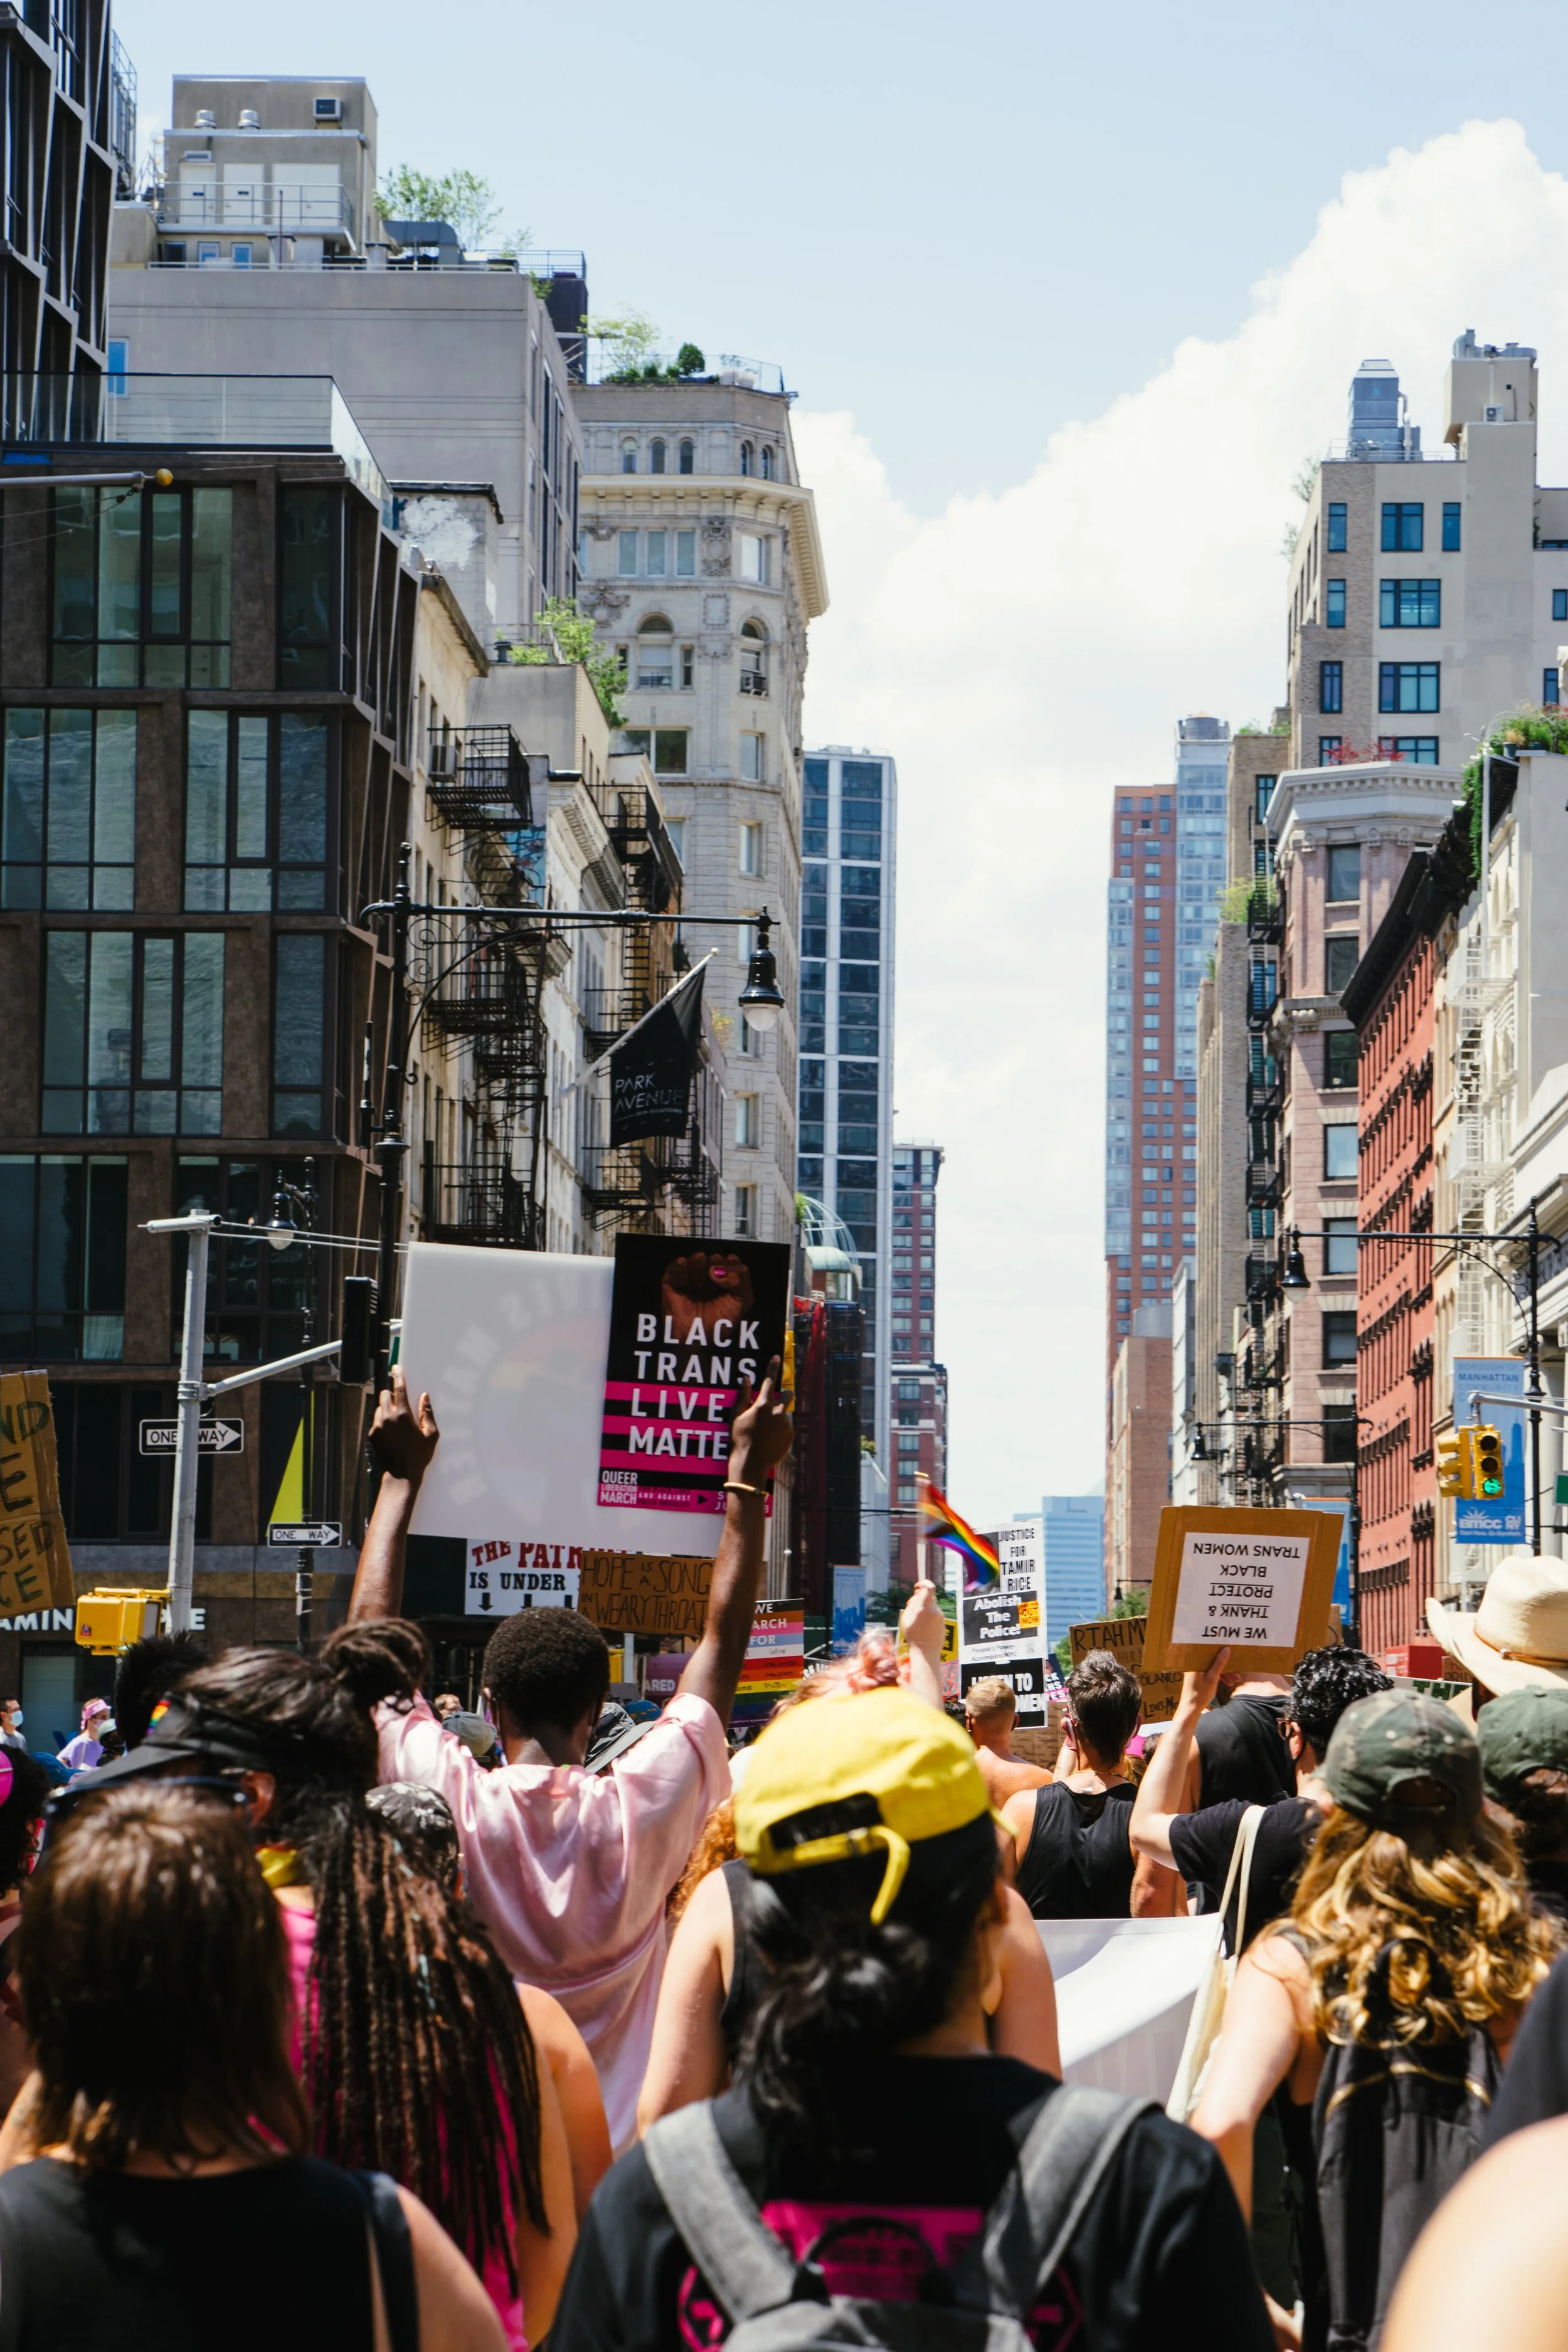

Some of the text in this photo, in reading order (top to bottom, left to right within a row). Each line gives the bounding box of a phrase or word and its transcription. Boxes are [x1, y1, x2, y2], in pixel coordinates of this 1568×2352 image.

[615, 1073, 656, 1094] PARK
[615, 1090, 684, 1115] AVENUE
[637, 1313, 760, 1350] BLACK
[633, 1350, 757, 1385] TRANS
[1458, 1373, 1519, 1382] MANHATTAN
[631, 1387, 725, 1422] LIVE
[150, 1430, 229, 1443] ONE WAY
[628, 1425, 729, 1460] MATTE
[602, 1470, 638, 1485] QUEER
[601, 1483, 638, 1493] LIBERATION
[600, 1491, 637, 1505] MARCH
[657, 1493, 691, 1502] AGAINST
[275, 1530, 331, 1539] ONE WAY
[999, 1528, 1035, 1542] JUSTICE
[472, 1540, 512, 1567] THE
[1010, 1545, 1027, 1557] FOR
[1194, 1543, 1300, 1559] TRANS WOMEN
[582, 1555, 712, 1595] HOPE IS A SONG
[1000, 1559, 1036, 1576] TAMIR
[1219, 1564, 1267, 1577] BLACK
[470, 1572, 566, 1591] IS UNDER
[1008, 1576, 1031, 1592] RICE
[1209, 1585, 1274, 1599] PROTECT
[973, 1594, 1022, 1611] Abolish
[581, 1592, 592, 1603] IN
[596, 1592, 652, 1626] WEARY
[653, 1595, 709, 1631] THROAT
[985, 1611, 1011, 1623] The
[1208, 1606, 1269, 1619] THANK &
[753, 1618, 787, 1630] ARCH
[980, 1623, 1022, 1640] Police!
[750, 1634, 776, 1646] FOR
[1073, 1624, 1125, 1652] RIAH
[1202, 1626, 1267, 1639] WE MUST
[972, 1673, 1033, 1692] LIEN TO
[1044, 1672, 1060, 1682] CK
[1015, 1693, 1047, 1713] OMEN
